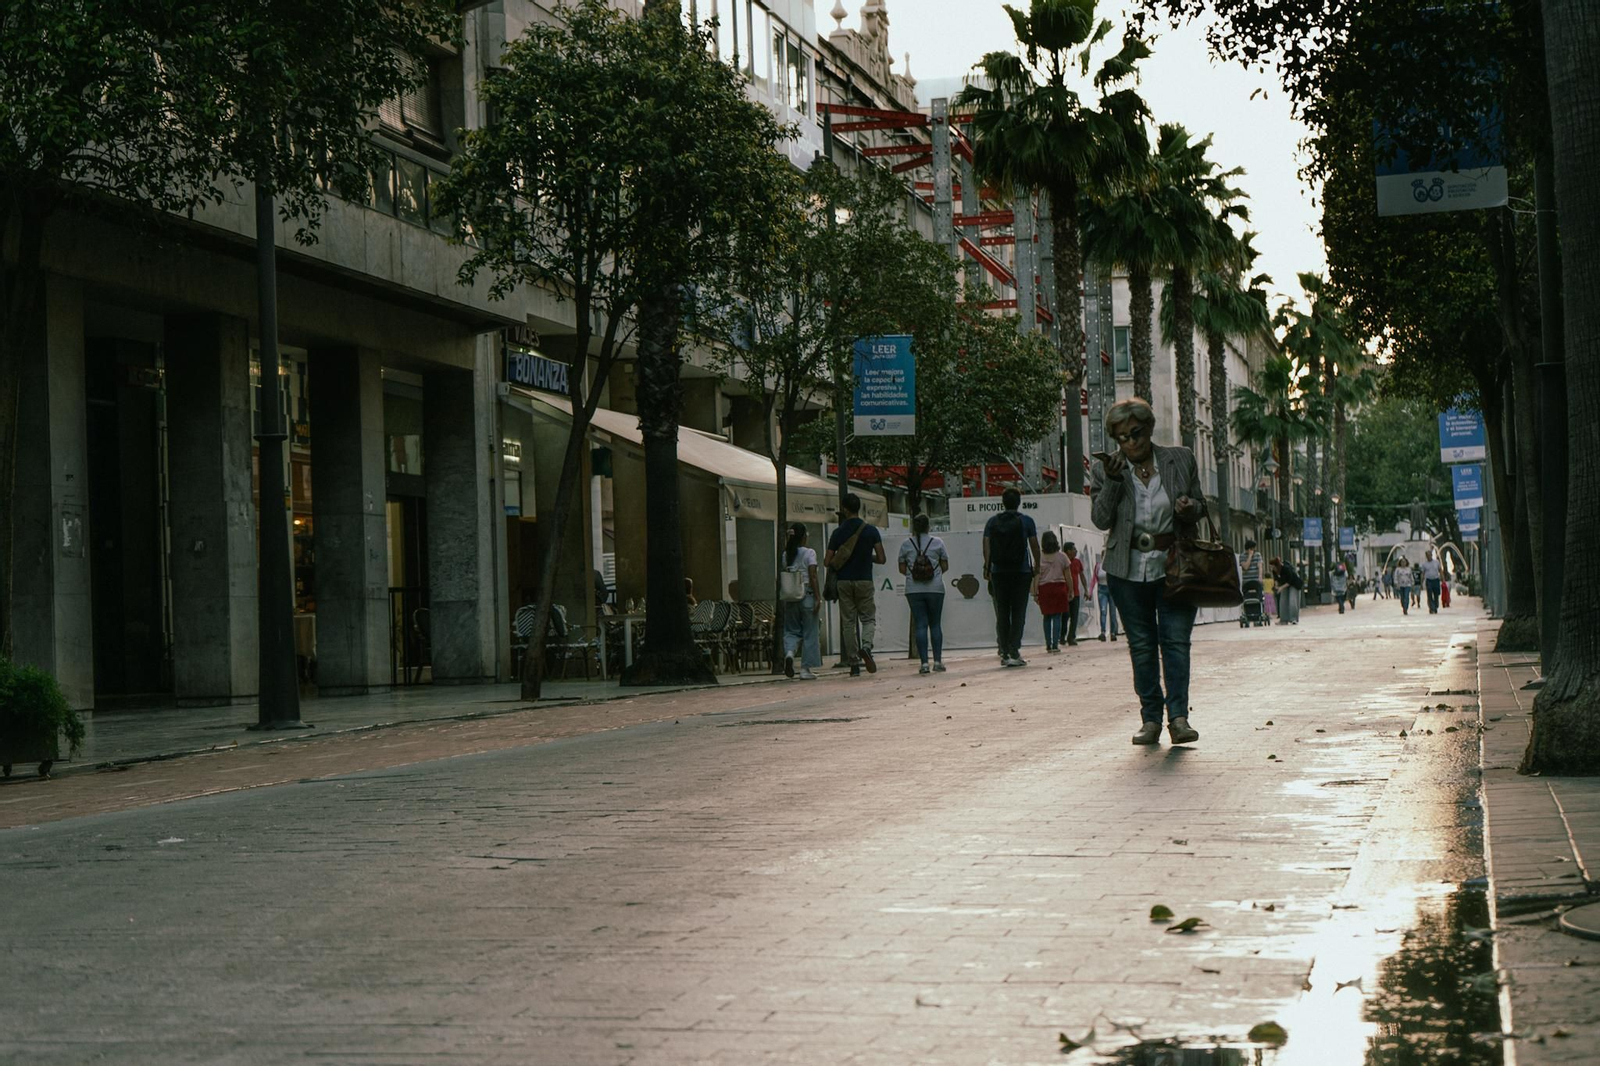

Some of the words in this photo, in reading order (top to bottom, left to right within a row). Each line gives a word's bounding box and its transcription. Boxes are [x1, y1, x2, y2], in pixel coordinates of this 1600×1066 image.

[872, 345, 897, 354] LEER
[516, 354, 569, 395] BONANZA
[881, 369, 904, 377] mejora
[871, 376, 905, 384] capaciad
[866, 384, 898, 392] expresiva
[871, 391, 908, 399] habilidades
[967, 504, 976, 512] EL
[979, 503, 1005, 512] PICOTE
